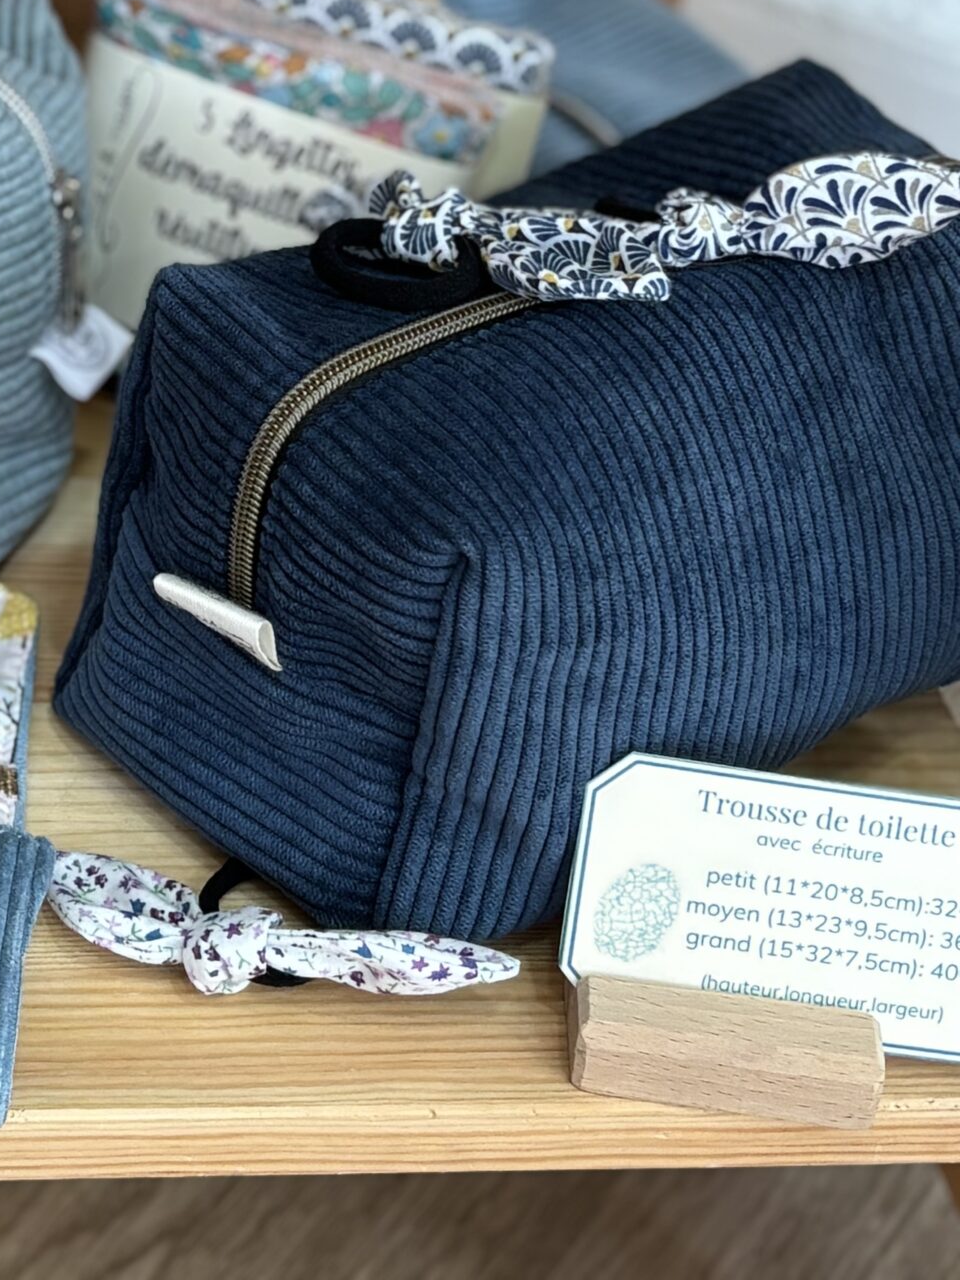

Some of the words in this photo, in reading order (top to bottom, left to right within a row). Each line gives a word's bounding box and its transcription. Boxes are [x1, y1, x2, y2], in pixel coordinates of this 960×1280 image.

[698, 789, 808, 827] Trousse
[815, 806, 849, 832] de
[858, 813, 956, 848] toilette
[756, 833, 802, 852] avec
[811, 838, 884, 864] écriture
[706, 870, 757, 890] petit
[686, 899, 760, 923] moyen
[686, 931, 752, 953] grand
